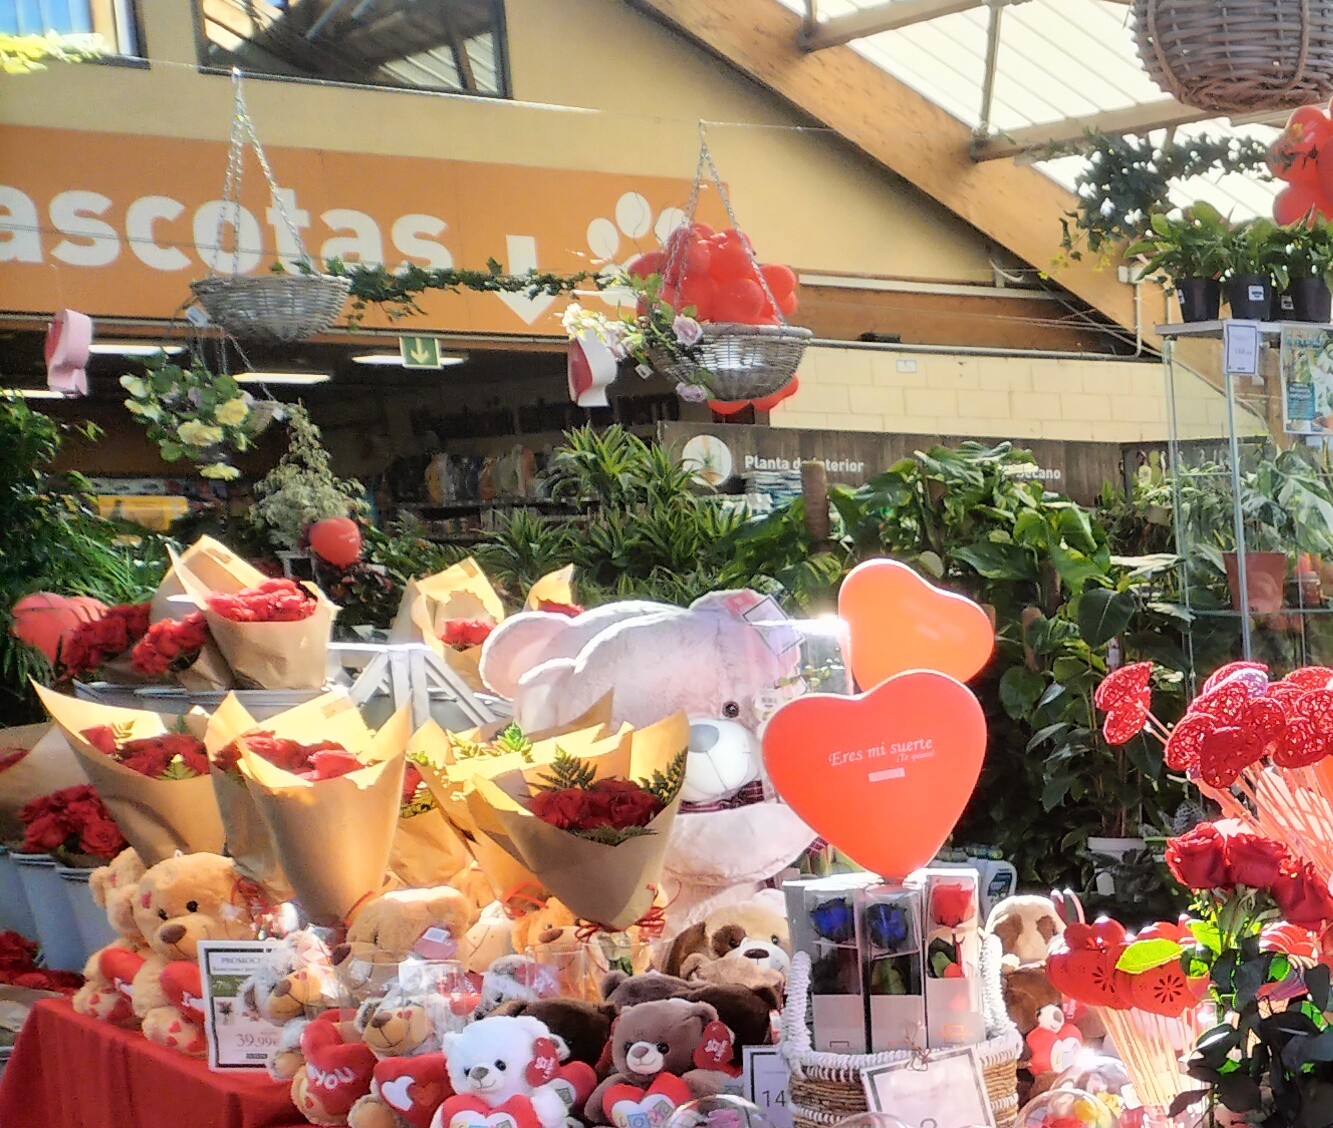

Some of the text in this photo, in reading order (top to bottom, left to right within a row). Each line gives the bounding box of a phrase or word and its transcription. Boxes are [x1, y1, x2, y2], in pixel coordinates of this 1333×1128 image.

[744, 455, 789, 469] Planta
[828, 738, 932, 766] Eres mi suerte
